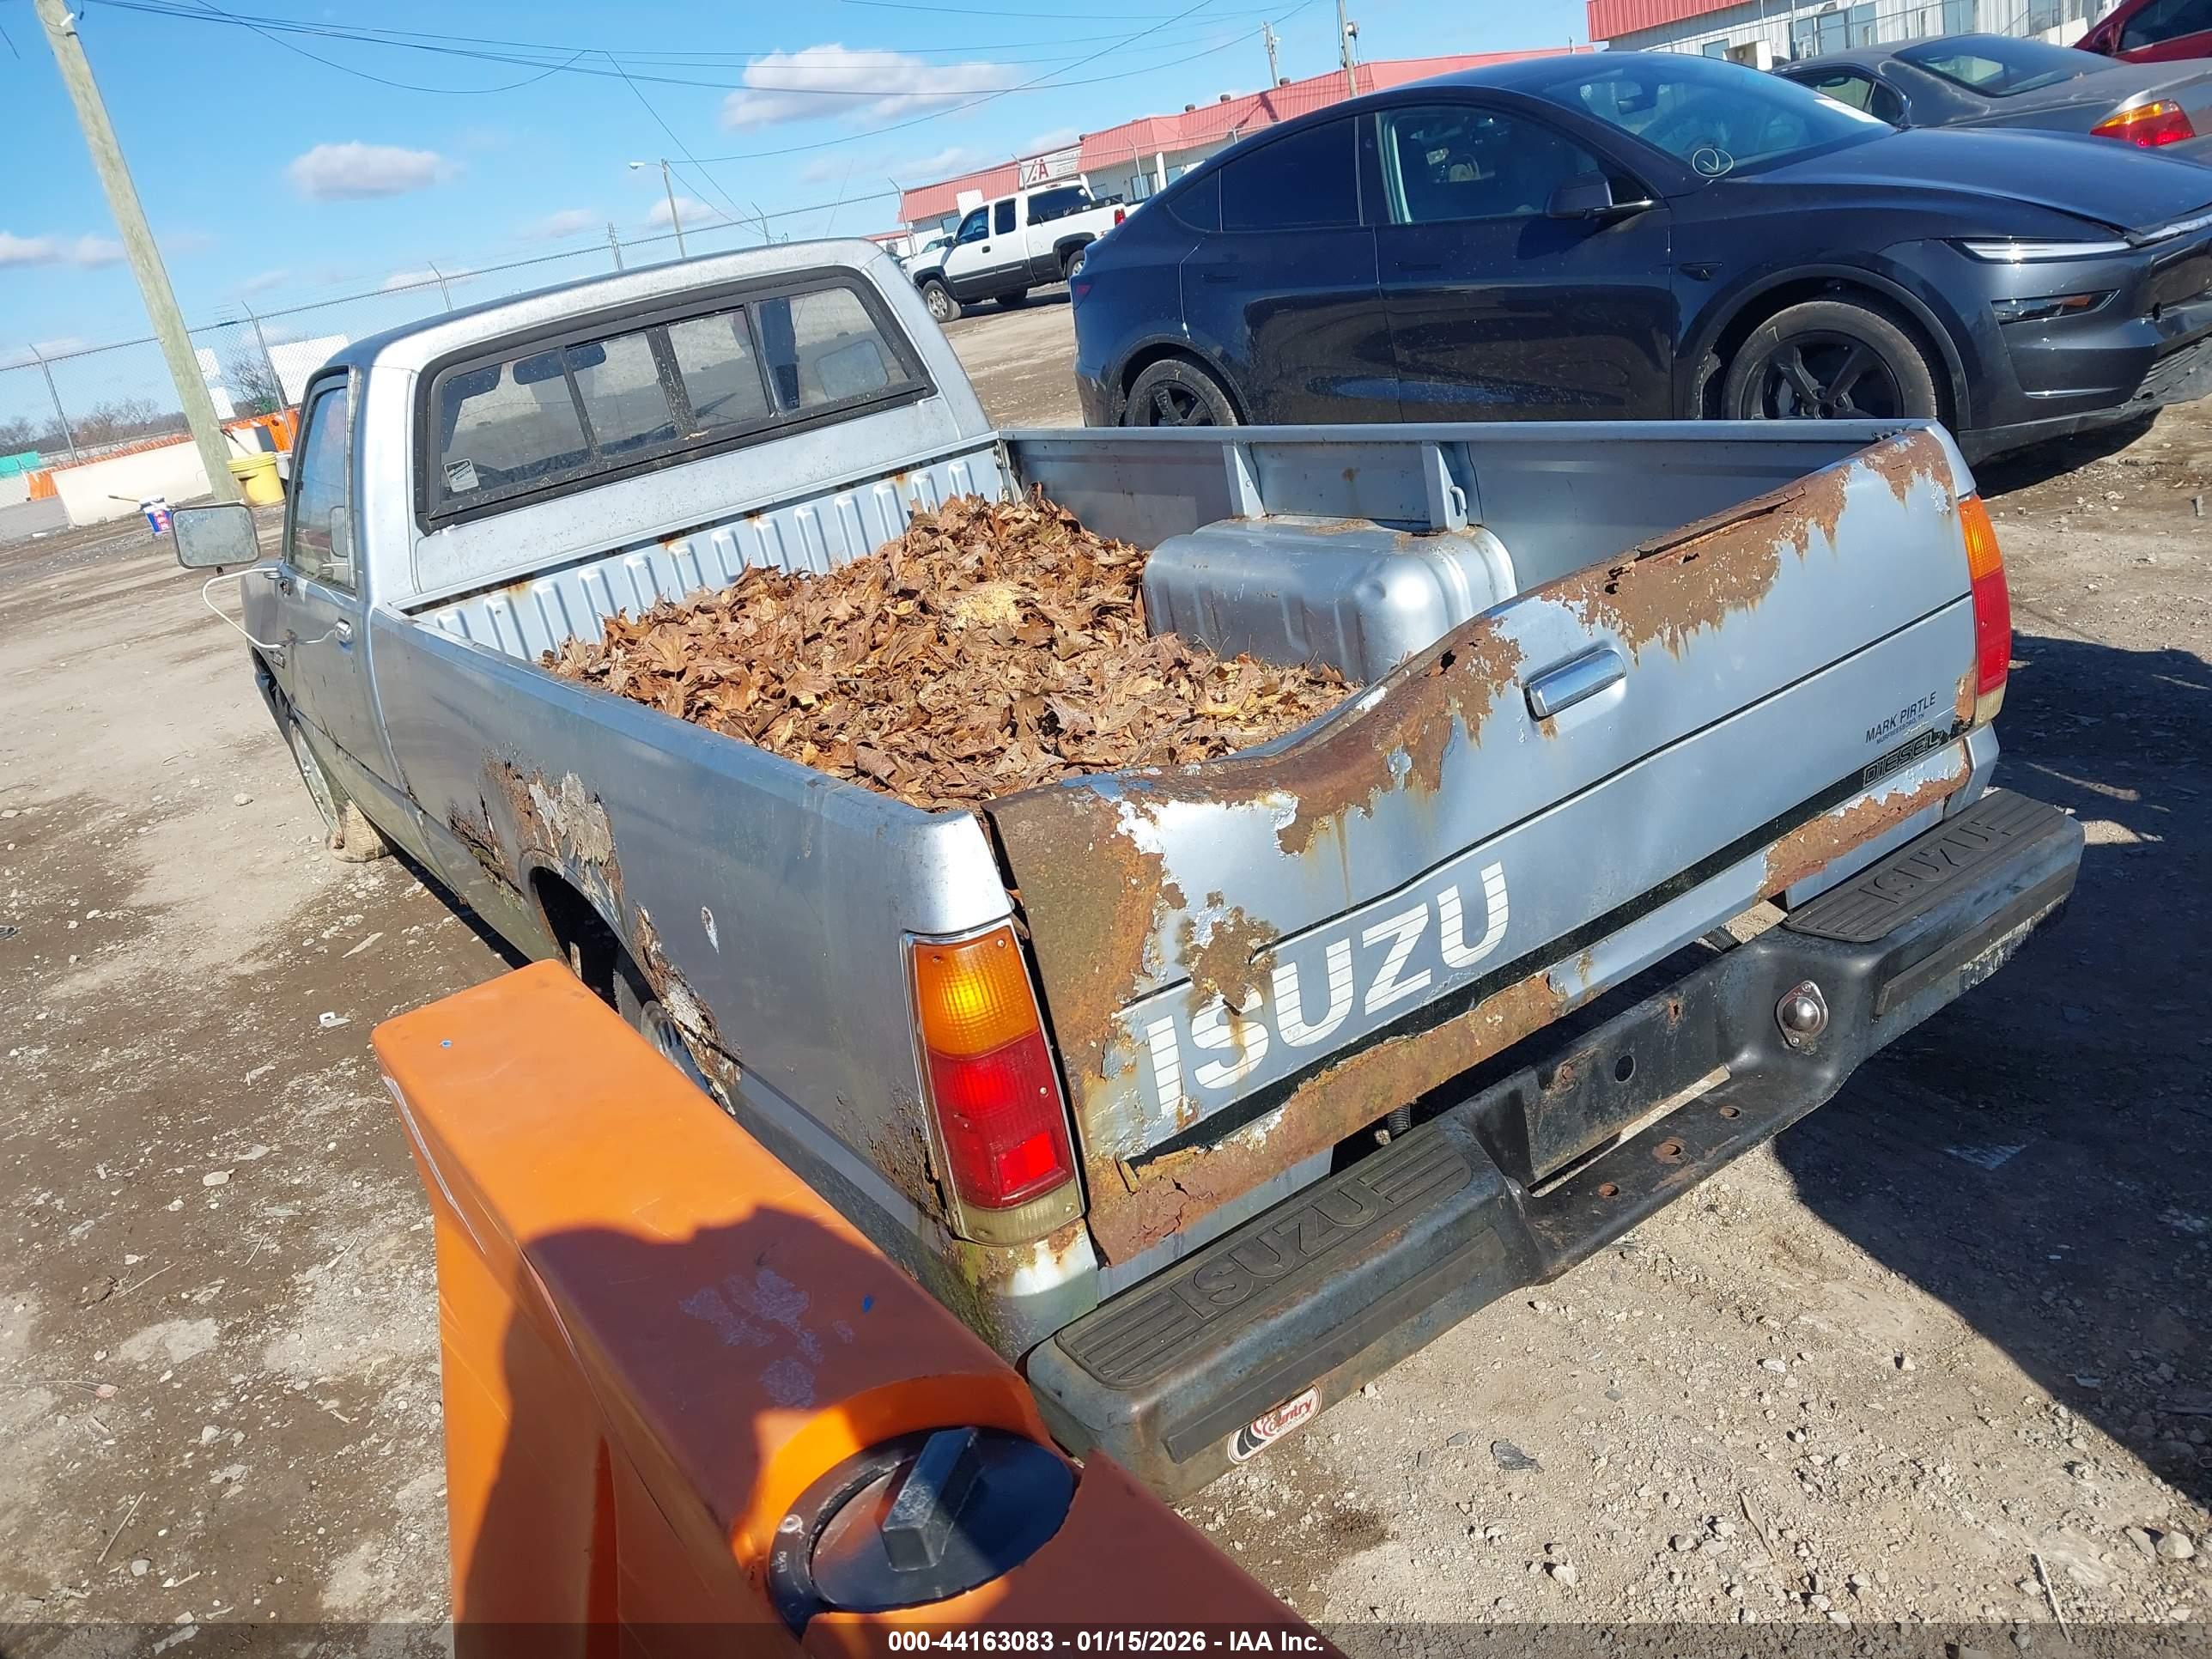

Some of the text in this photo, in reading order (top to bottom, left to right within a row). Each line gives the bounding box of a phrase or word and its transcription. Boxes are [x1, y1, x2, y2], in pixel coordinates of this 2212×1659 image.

[1863, 728, 1940, 788] DIESEL
[1865, 690, 1937, 744] MARK PIRTLE
[1857, 823, 2001, 905] ISUZU
[1146, 860, 1510, 1115] ISUZU
[1170, 1182, 1379, 1321] ISUZU
